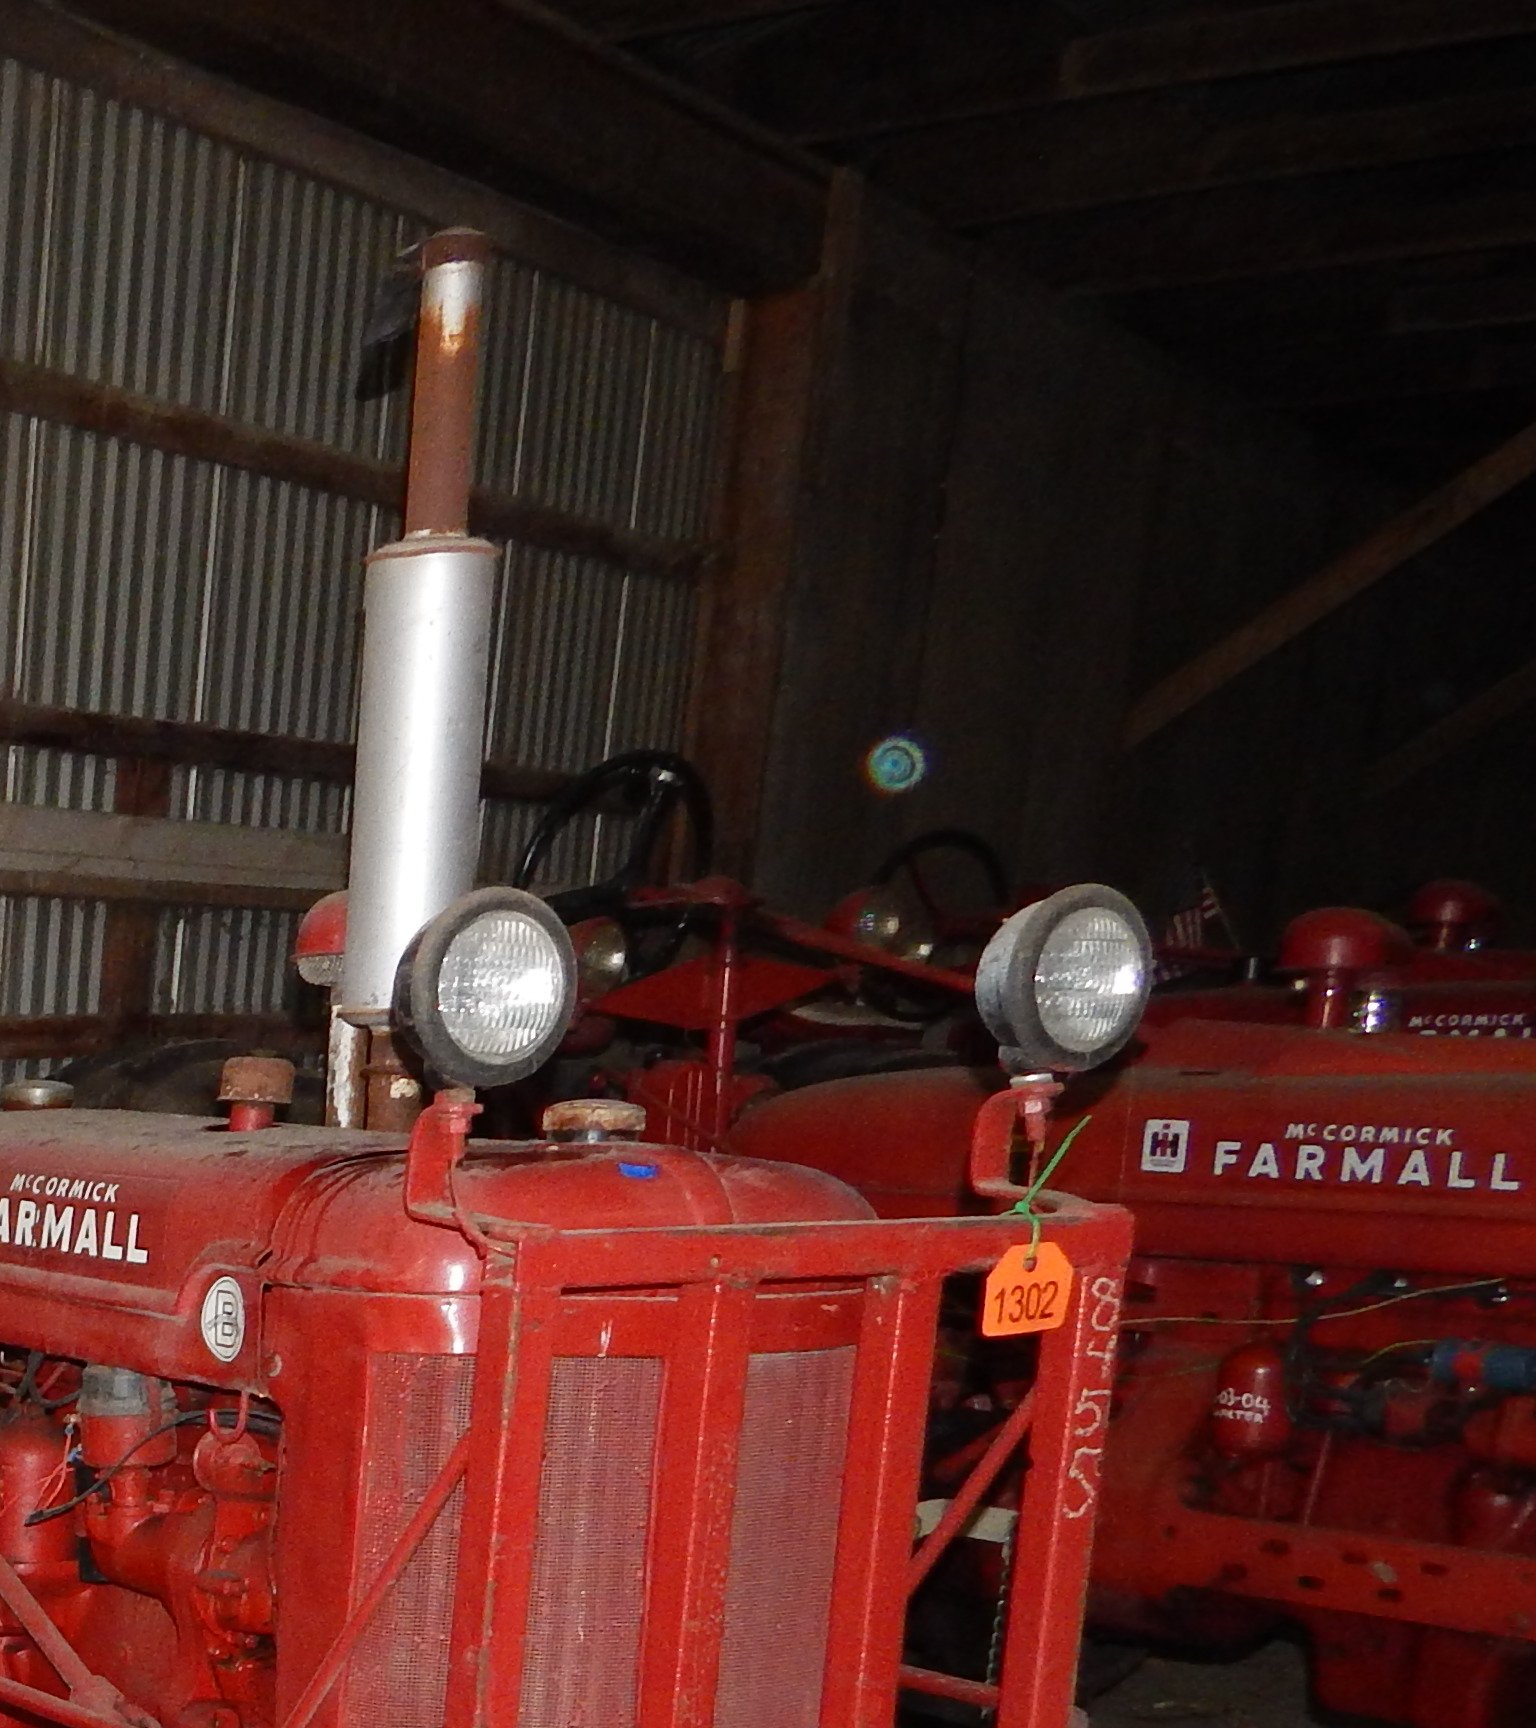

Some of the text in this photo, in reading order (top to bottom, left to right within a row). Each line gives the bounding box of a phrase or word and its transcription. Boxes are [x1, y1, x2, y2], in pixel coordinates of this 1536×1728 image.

[9, 1172, 121, 1204] McCORMICK
[1212, 1140, 1521, 1192] FARMALL
[214, 1289, 239, 1349] B
[993, 1280, 1059, 1325] 1302
